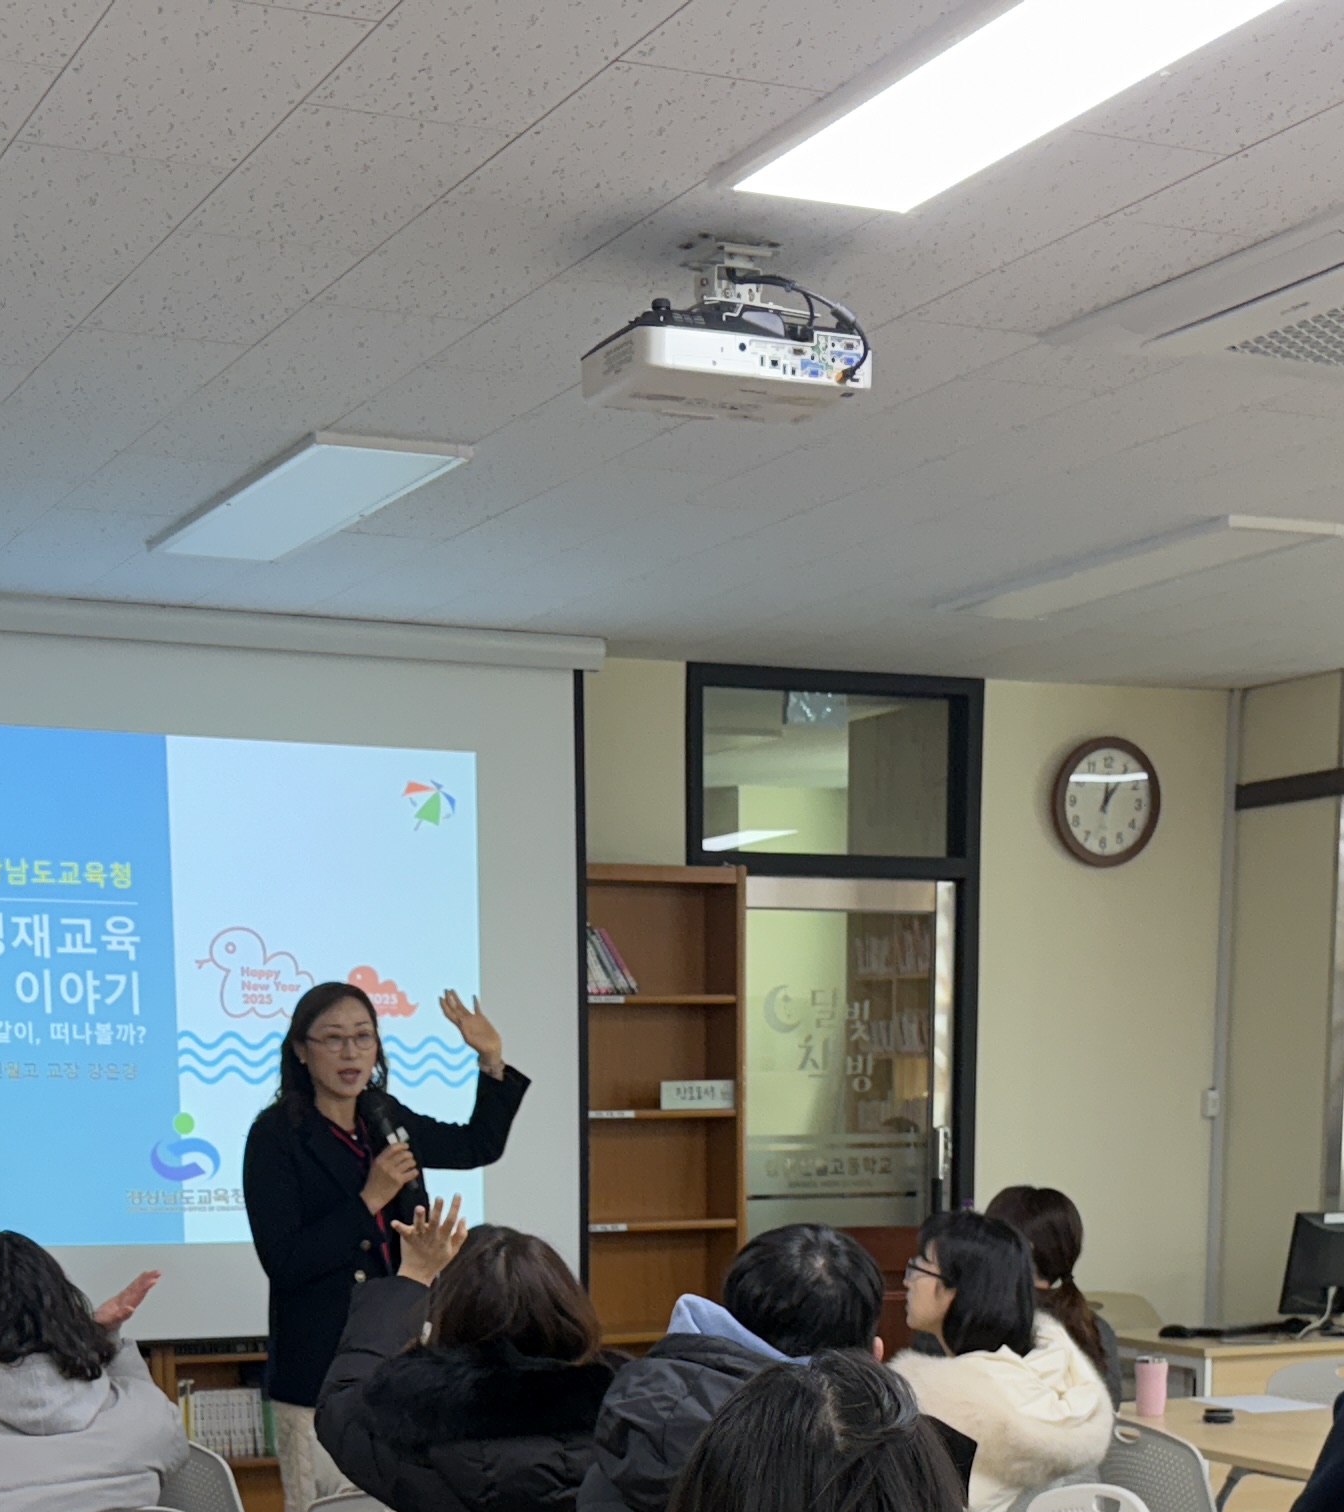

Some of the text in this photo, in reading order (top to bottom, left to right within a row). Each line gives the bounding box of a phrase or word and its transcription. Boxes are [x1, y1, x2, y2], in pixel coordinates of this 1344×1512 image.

[240, 966, 281, 980] Happy
[15, 968, 140, 1016] 이야기
[241, 980, 302, 993] New Year
[242, 993, 273, 1005] 2025
[49, 1021, 147, 1046] 떠나볼까?
[47, 1062, 80, 1080] 교장
